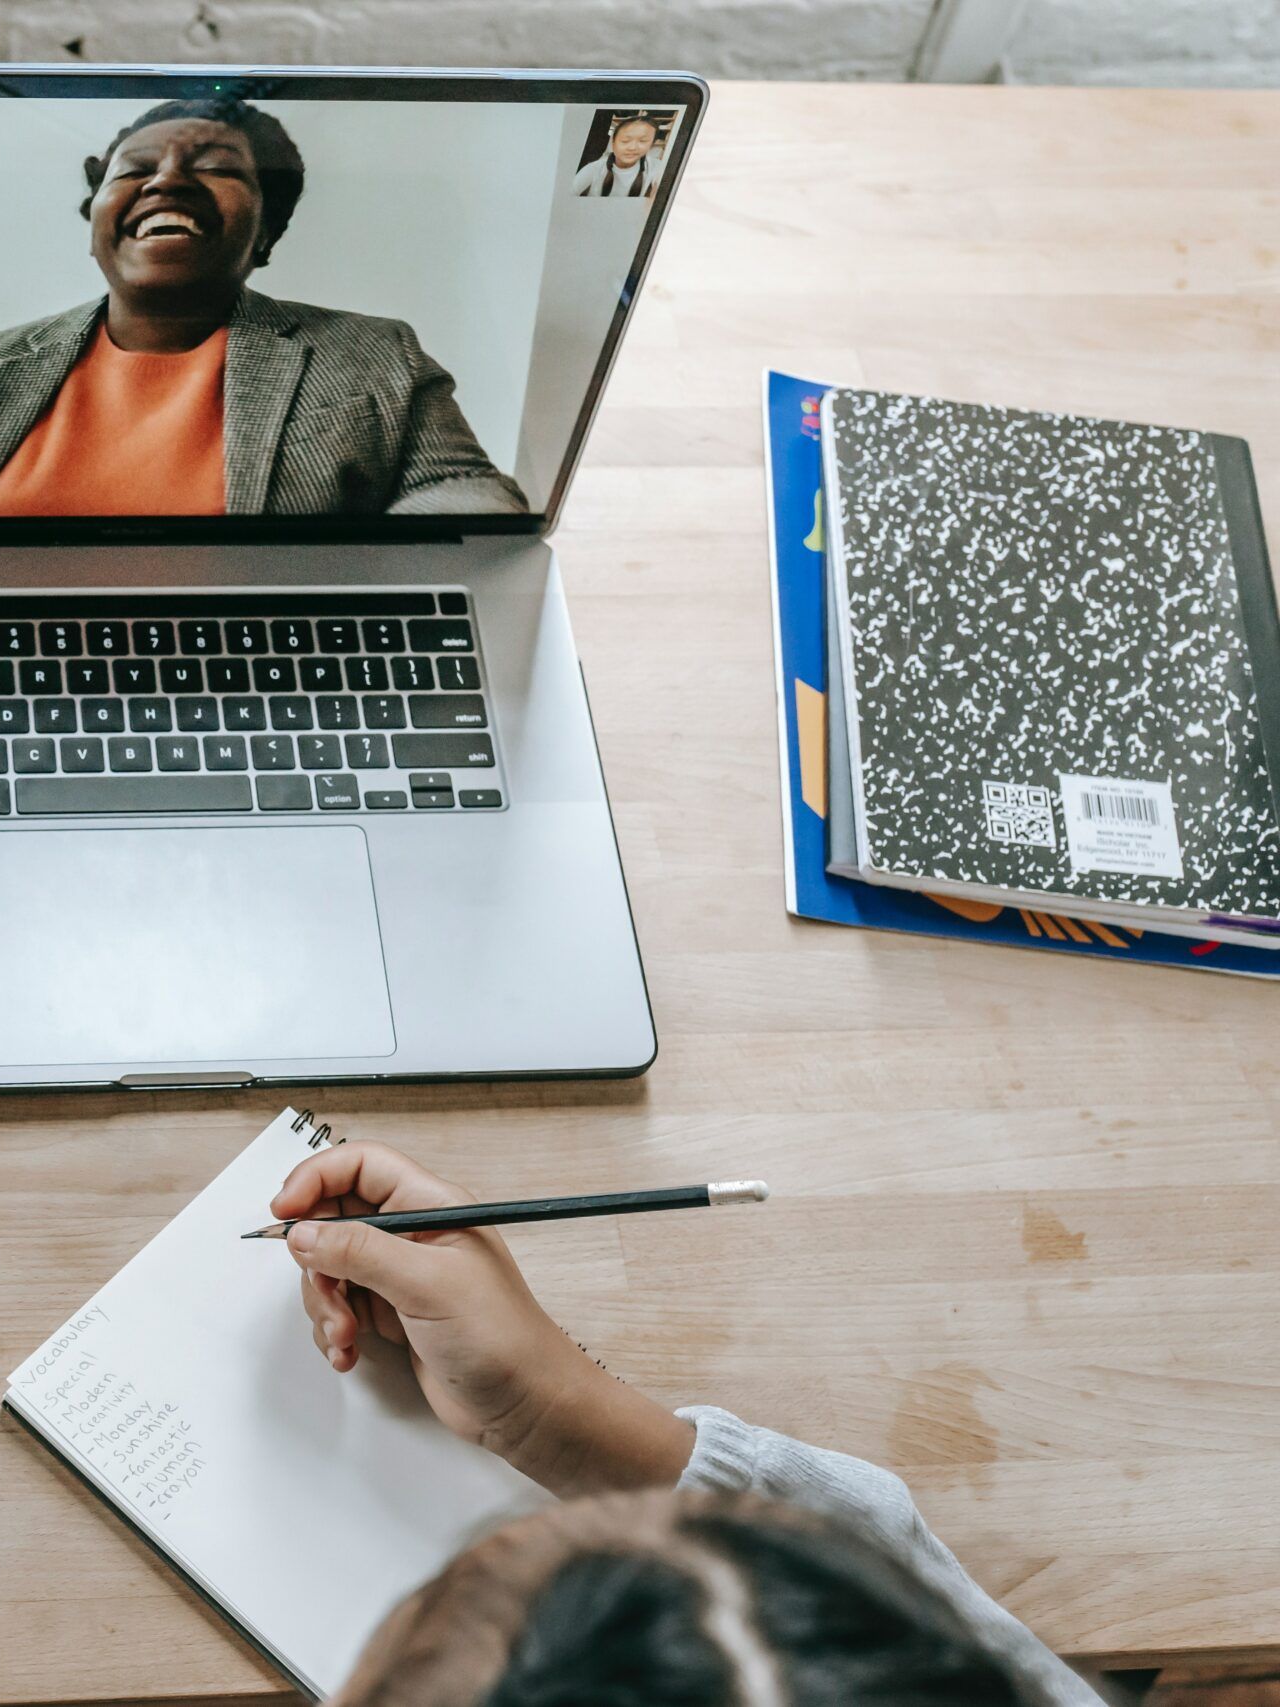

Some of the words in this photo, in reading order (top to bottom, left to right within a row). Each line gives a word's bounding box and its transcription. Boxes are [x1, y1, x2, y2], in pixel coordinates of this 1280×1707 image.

[9, 638, 20, 650] 4
[56, 637, 67, 650] 5
[102, 637, 114, 649] 6
[149, 636, 160, 649] 7
[196, 636, 206, 649] 8
[242, 636, 253, 648] 9
[288, 635, 299, 648] 0
[34, 670, 46, 683] R
[82, 669, 93, 682] T
[129, 669, 140, 682] Y
[175, 669, 188, 681] U
[225, 668, 232, 681] I
[268, 667, 281, 680] O
[315, 667, 326, 680] P
[1, 709, 14, 722] D
[50, 708, 60, 721] F
[97, 708, 109, 721] G
[144, 708, 157, 720] H
[193, 707, 203, 720] J
[239, 706, 251, 719] K
[286, 706, 297, 719] L
[29, 748, 40, 761] C
[76, 748, 88, 760] V
[125, 747, 136, 760] B
[172, 747, 185, 759] N
[219, 746, 232, 758] M
[468, 752, 489, 762] shift
[323, 794, 352, 805] option
